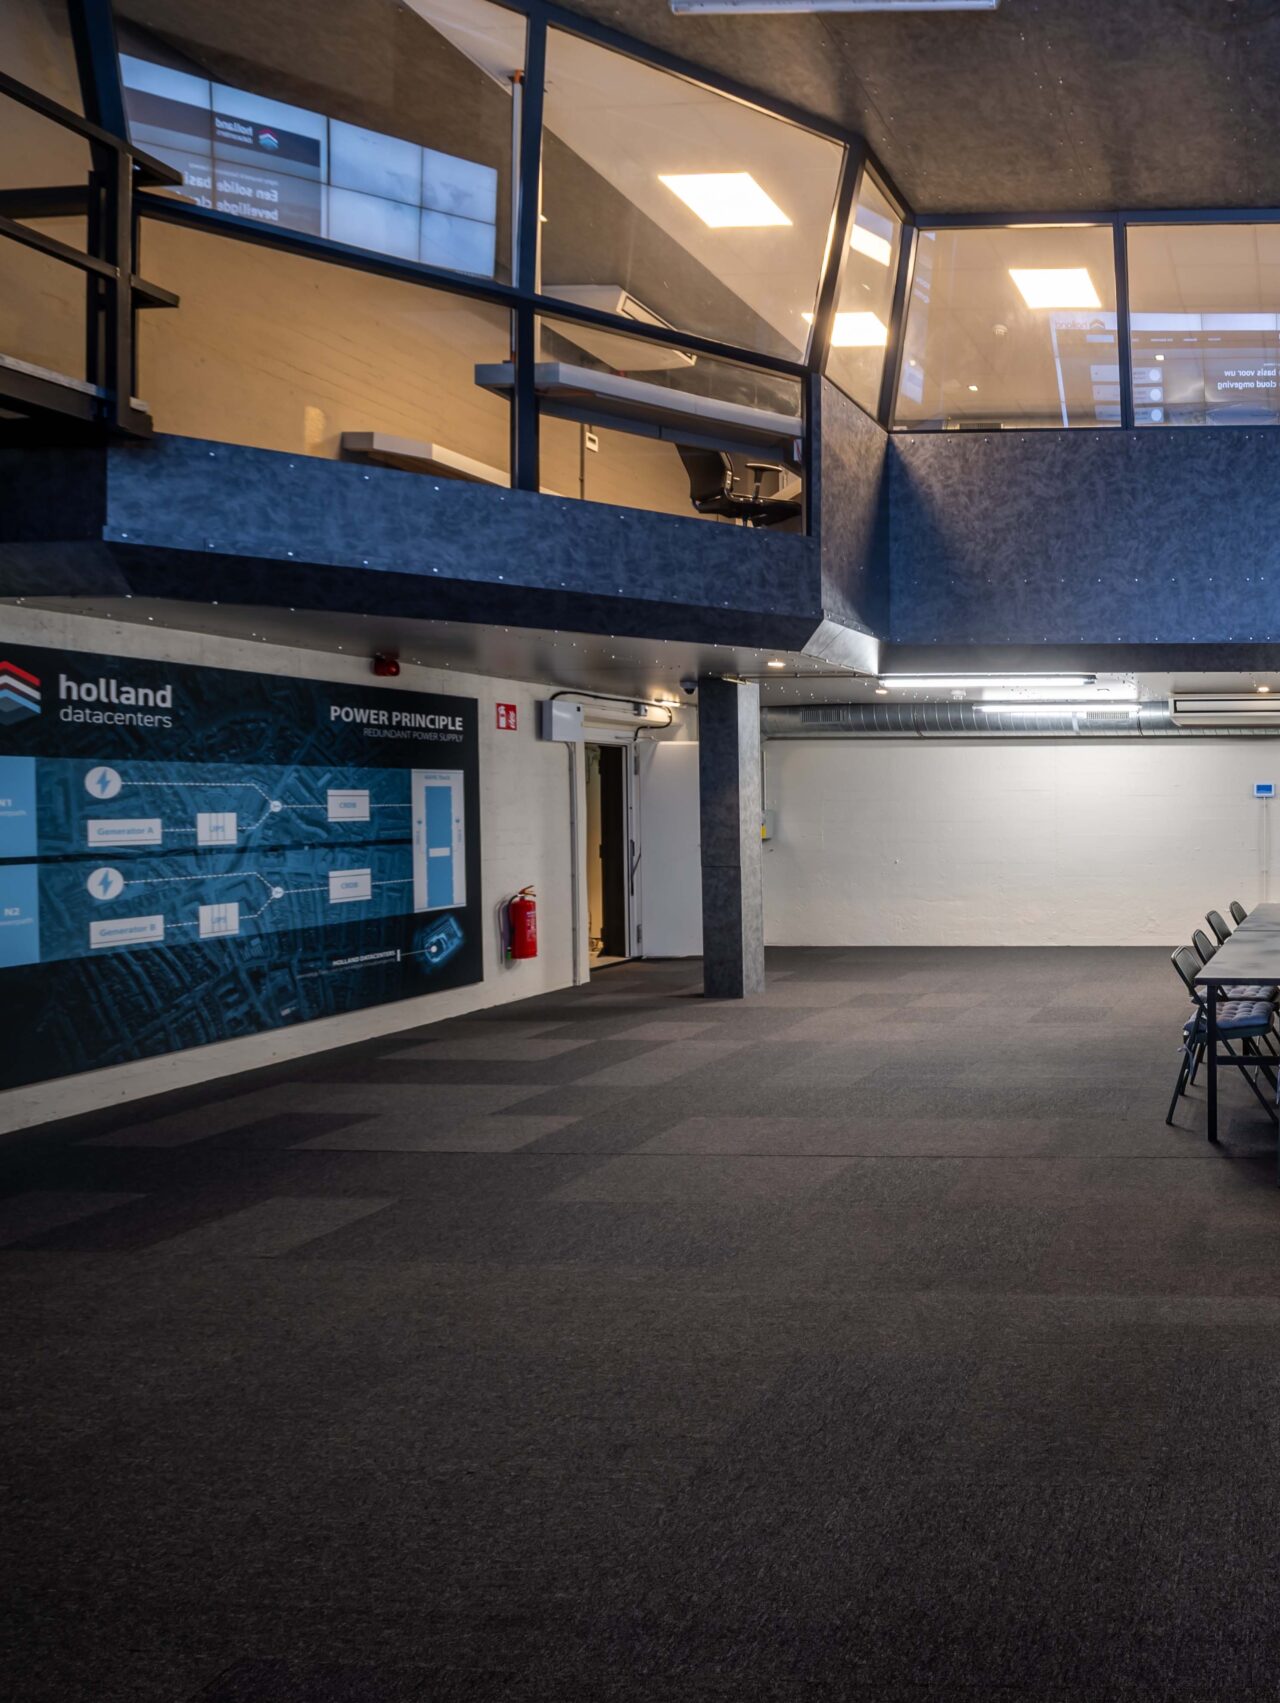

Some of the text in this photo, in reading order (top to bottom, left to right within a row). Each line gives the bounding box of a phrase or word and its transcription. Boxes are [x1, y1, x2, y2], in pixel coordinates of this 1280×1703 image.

[59, 673, 173, 708] holland
[59, 705, 173, 728] datacenters
[330, 705, 463, 731] POWER PRINCIPLE
[363, 727, 463, 742] REDUNDANT POWER SUPPLY
